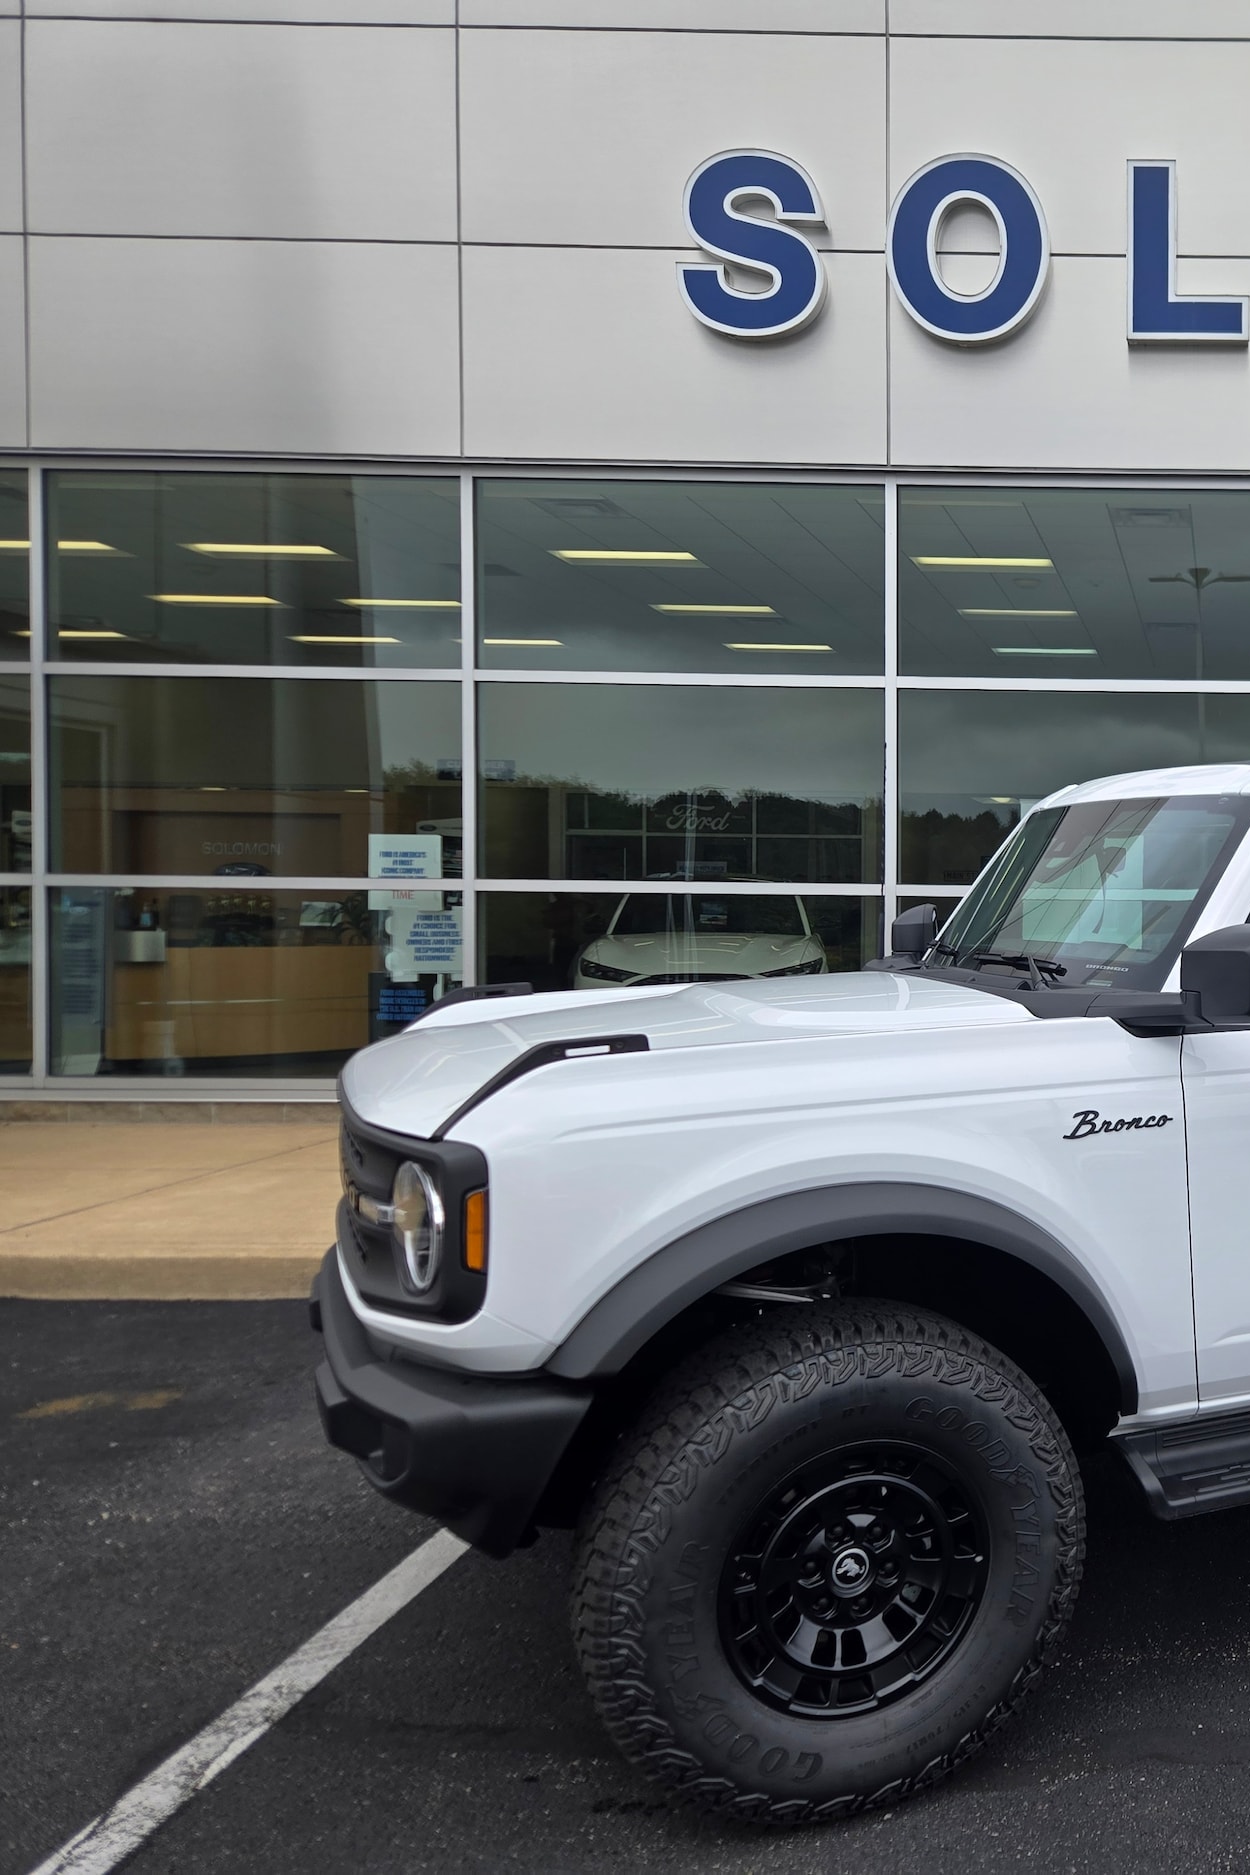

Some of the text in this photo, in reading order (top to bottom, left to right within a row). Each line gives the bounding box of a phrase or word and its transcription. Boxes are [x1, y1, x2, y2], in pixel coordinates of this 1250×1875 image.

[666, 804, 731, 831] Ford
[202, 842, 281, 856] SOLOMON
[1085, 964, 1130, 973] BRONCO
[1063, 1110, 1173, 1139] Bronco
[905, 1396, 1041, 1627] GOODYEAR
[664, 1540, 824, 1784] GOODYEAR
